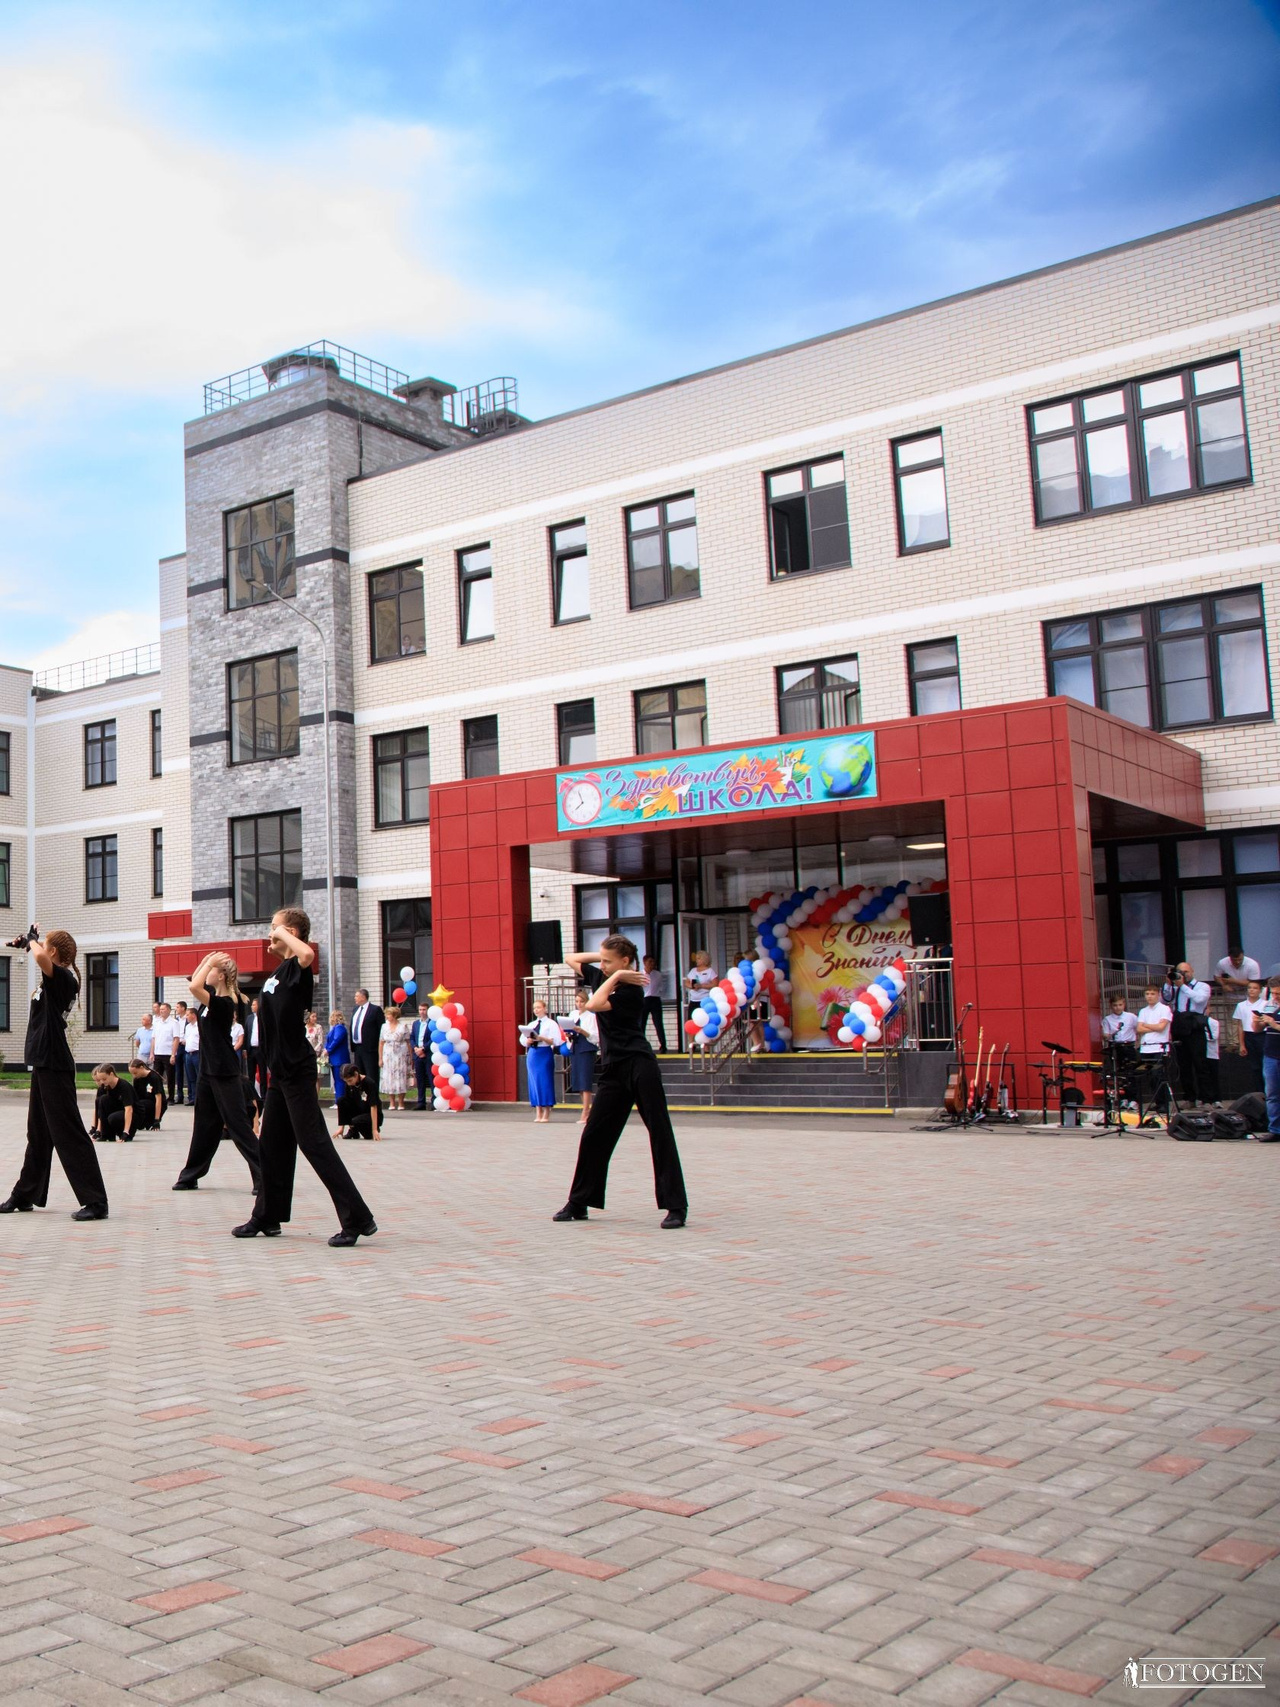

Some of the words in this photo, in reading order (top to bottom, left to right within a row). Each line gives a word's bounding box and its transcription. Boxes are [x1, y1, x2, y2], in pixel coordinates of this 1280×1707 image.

[605, 758, 767, 800] Здравствуй,
[677, 777, 813, 813] ШКОЛА!
[822, 923, 842, 948] С
